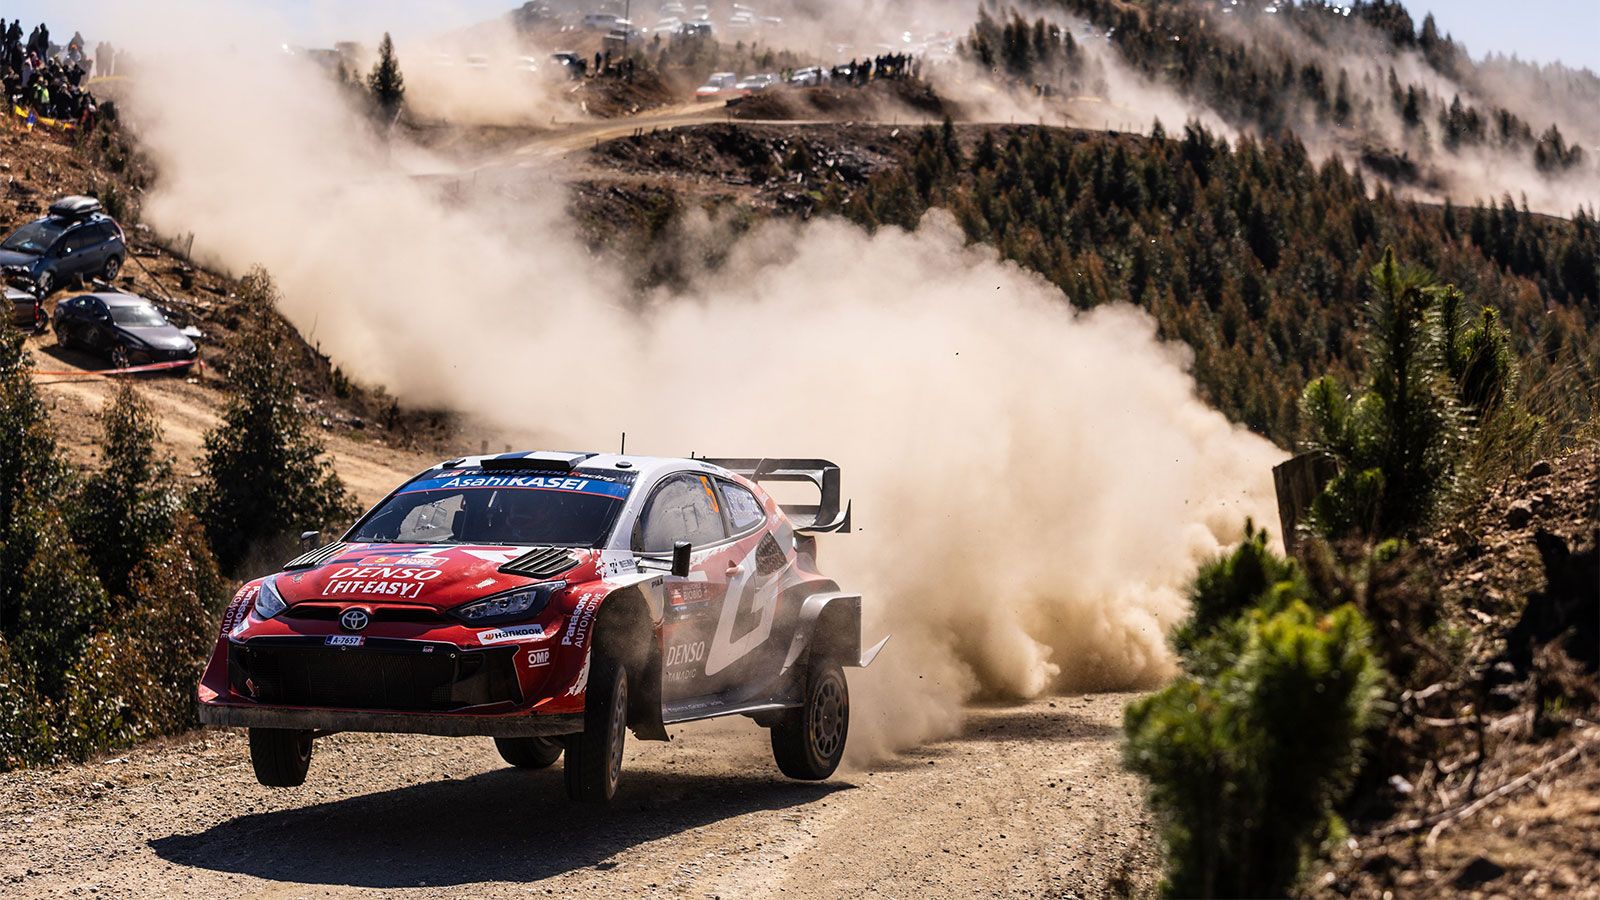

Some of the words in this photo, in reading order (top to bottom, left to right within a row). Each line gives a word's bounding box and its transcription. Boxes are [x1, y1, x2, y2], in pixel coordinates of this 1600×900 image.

[569, 471, 616, 482] Racing
[698, 475, 719, 513] 5
[329, 567, 443, 581] DENSO
[561, 593, 592, 646] Panasonic
[574, 593, 605, 648] AUTOMOTIVE
[331, 636, 360, 646] A-7657
[527, 652, 550, 665] OMP
[665, 641, 705, 667] DENSO
